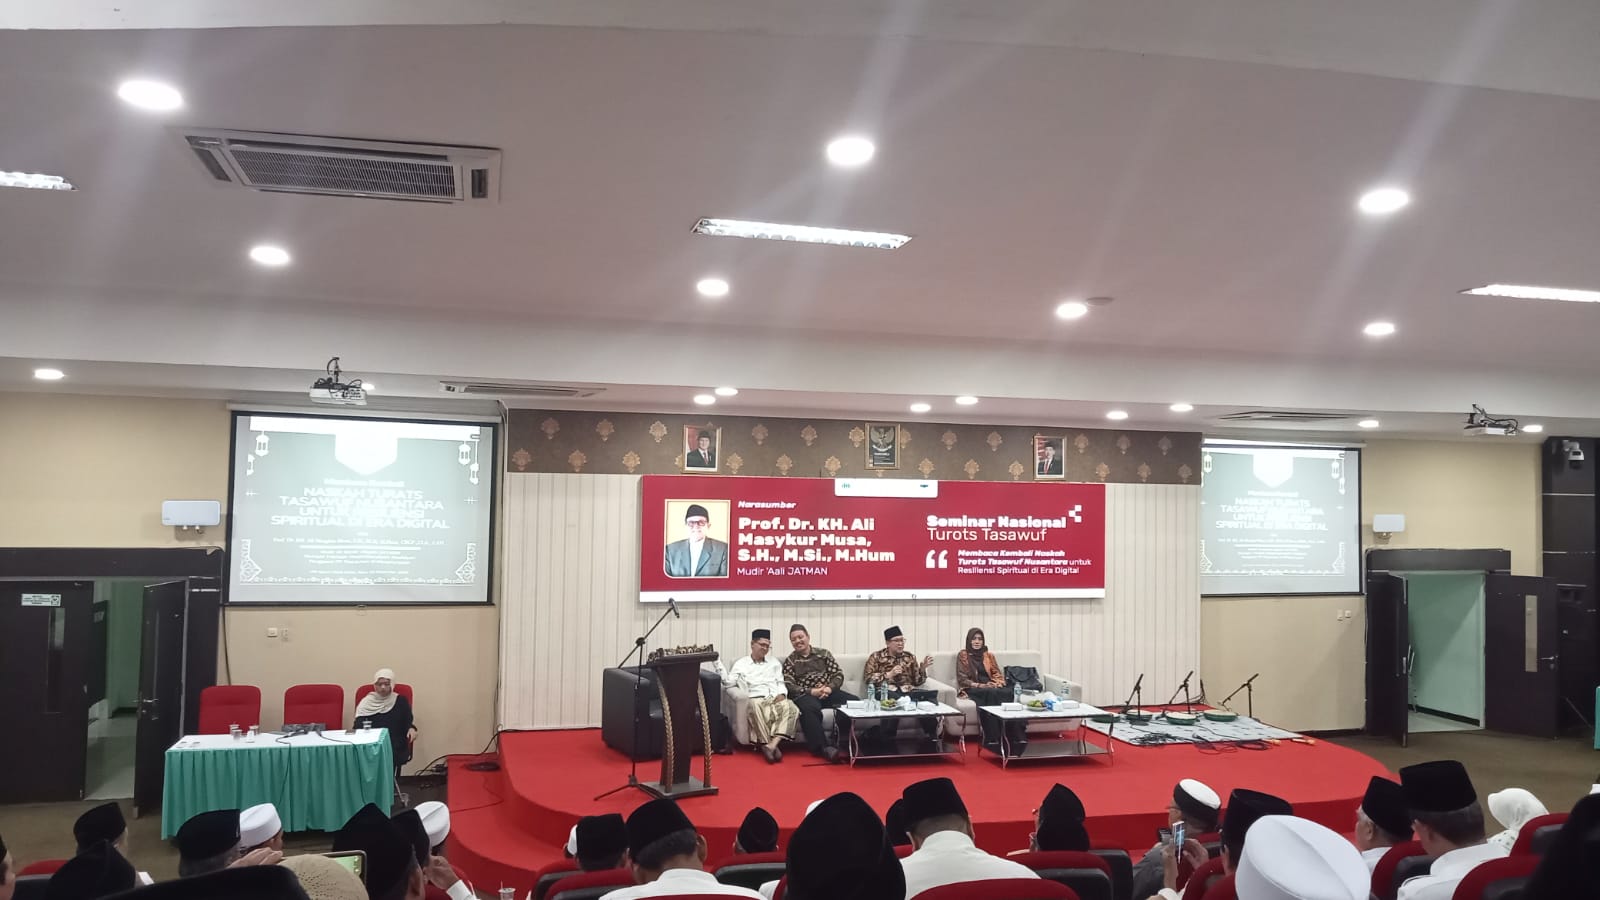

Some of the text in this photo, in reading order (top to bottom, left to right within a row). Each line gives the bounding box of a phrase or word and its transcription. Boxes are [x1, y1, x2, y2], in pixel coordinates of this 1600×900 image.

[738, 500, 797, 510] Narasumber
[271, 515, 345, 526] SPIRITUAL
[396, 518, 450, 529] DIGITAL
[738, 517, 875, 531] Prof. Dr. KH. Ali
[926, 515, 1066, 528] Seminar Nasional
[738, 533, 872, 548] Masykur Musa,
[927, 528, 1048, 542] Turots Tasawuf
[738, 549, 895, 562] S.H., M.Si., M.Hum
[736, 567, 764, 576] Mudir
[787, 567, 828, 576] JATMAN
[996, 566, 1030, 575] Spiritual
[1055, 567, 1080, 576] Digital
